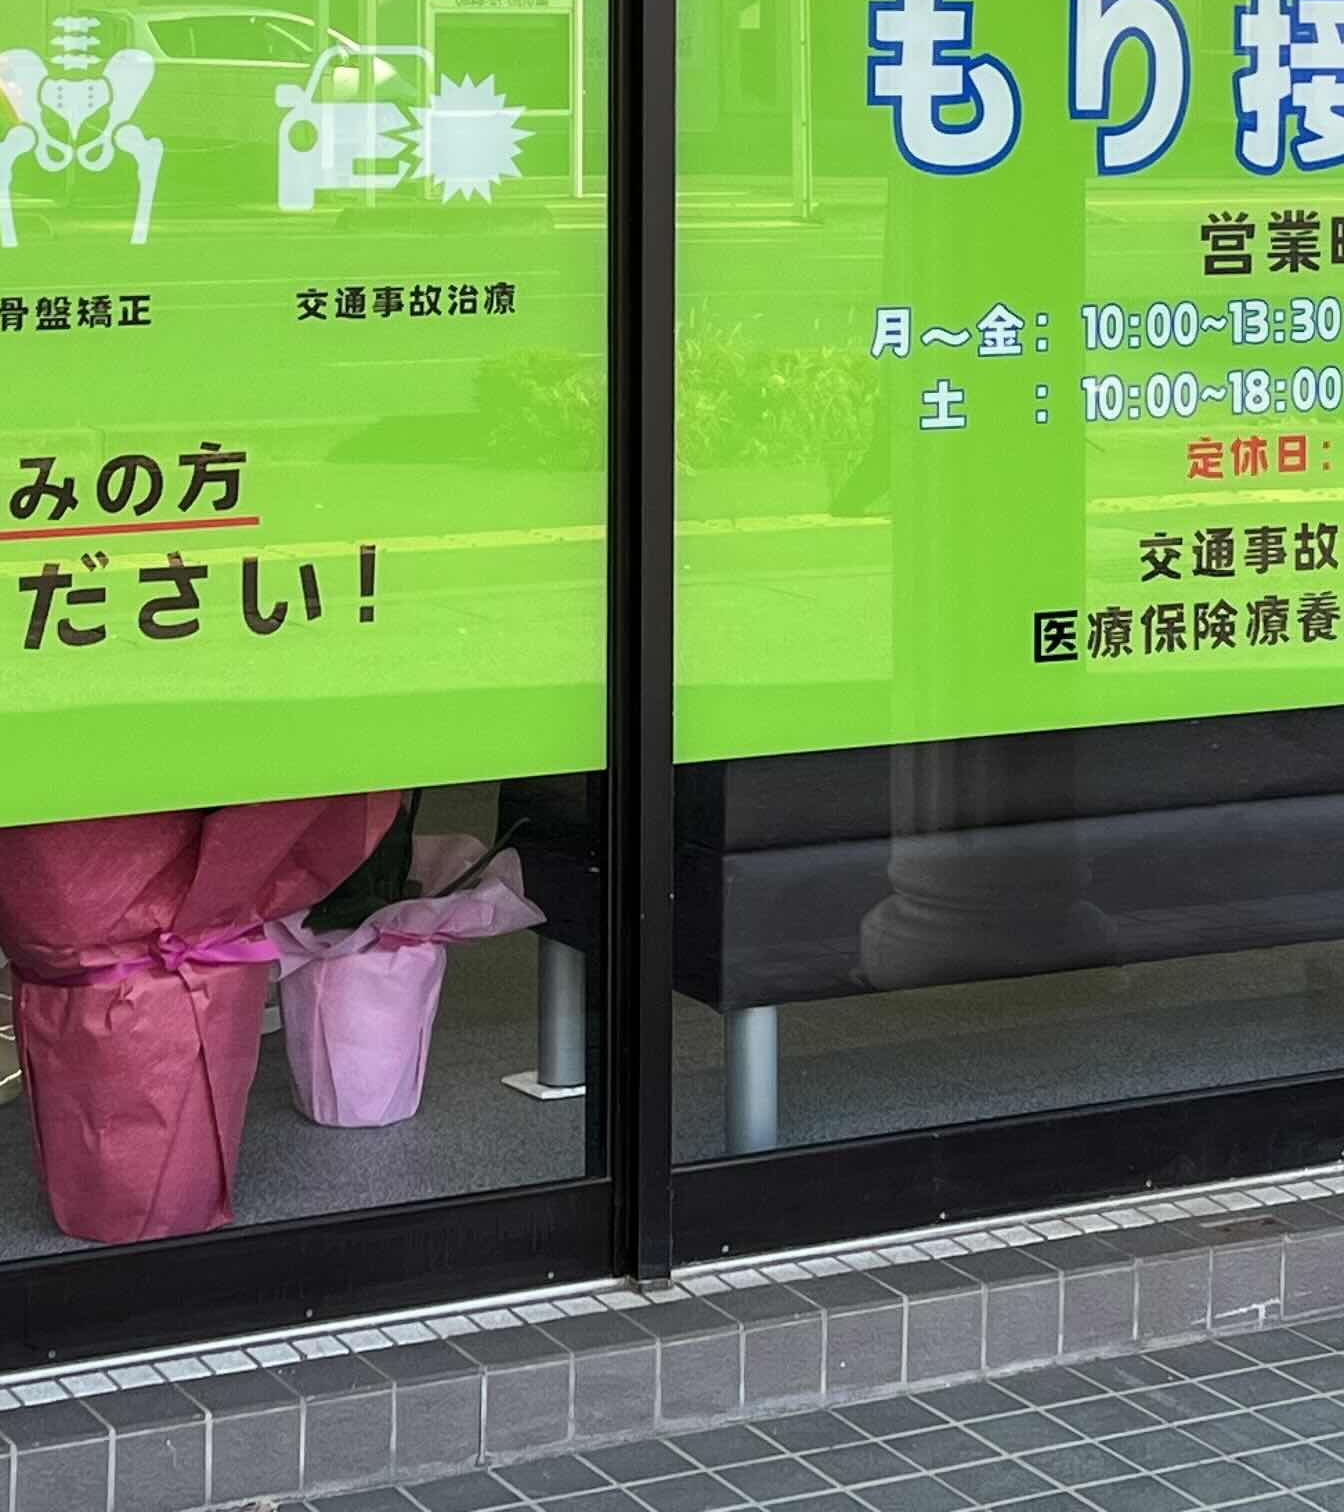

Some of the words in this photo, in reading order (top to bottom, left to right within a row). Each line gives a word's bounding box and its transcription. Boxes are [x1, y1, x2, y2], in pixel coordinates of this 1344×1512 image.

[295, 281, 517, 322] 交通事故治療
[919, 378, 967, 431] 土
